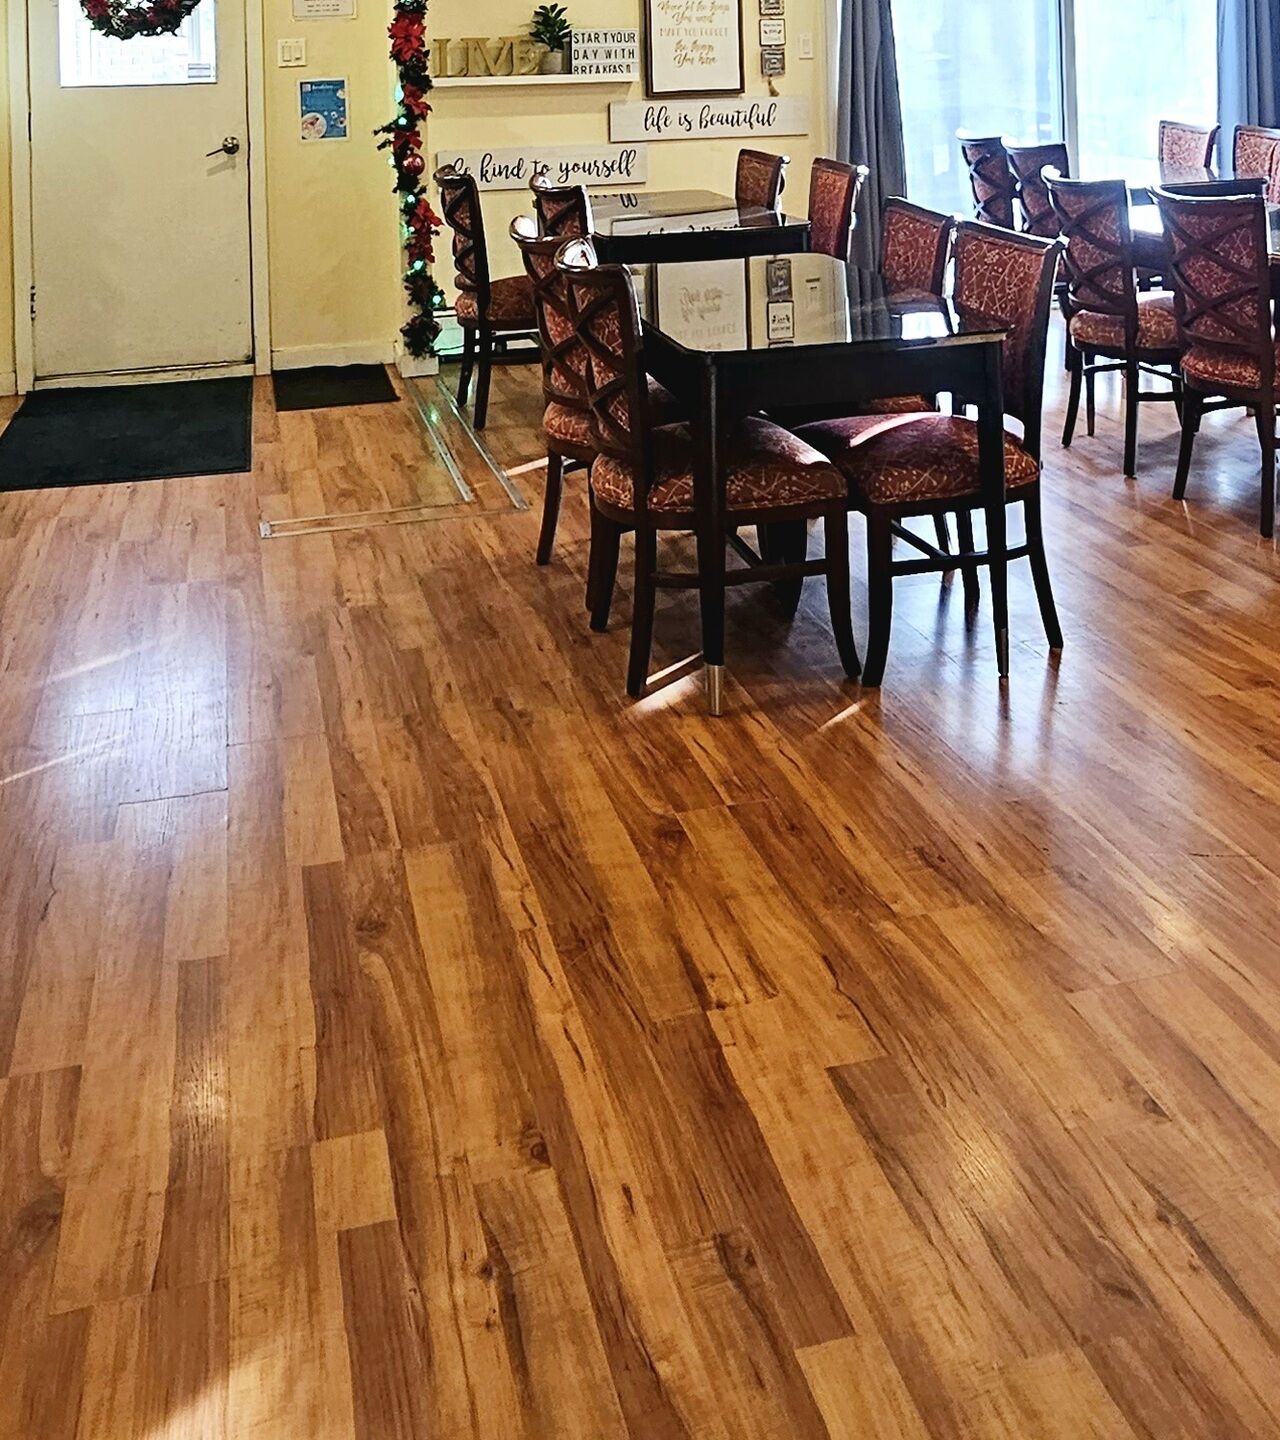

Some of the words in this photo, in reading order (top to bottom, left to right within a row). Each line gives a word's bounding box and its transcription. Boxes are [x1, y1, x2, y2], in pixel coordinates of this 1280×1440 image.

[573, 49, 599, 60] DAY
[604, 48, 635, 60] WITH
[644, 105, 672, 133] life
[678, 112, 692, 132] is
[699, 102, 777, 130] beautiful
[480, 153, 528, 183] kind
[557, 149, 637, 184] yourself
